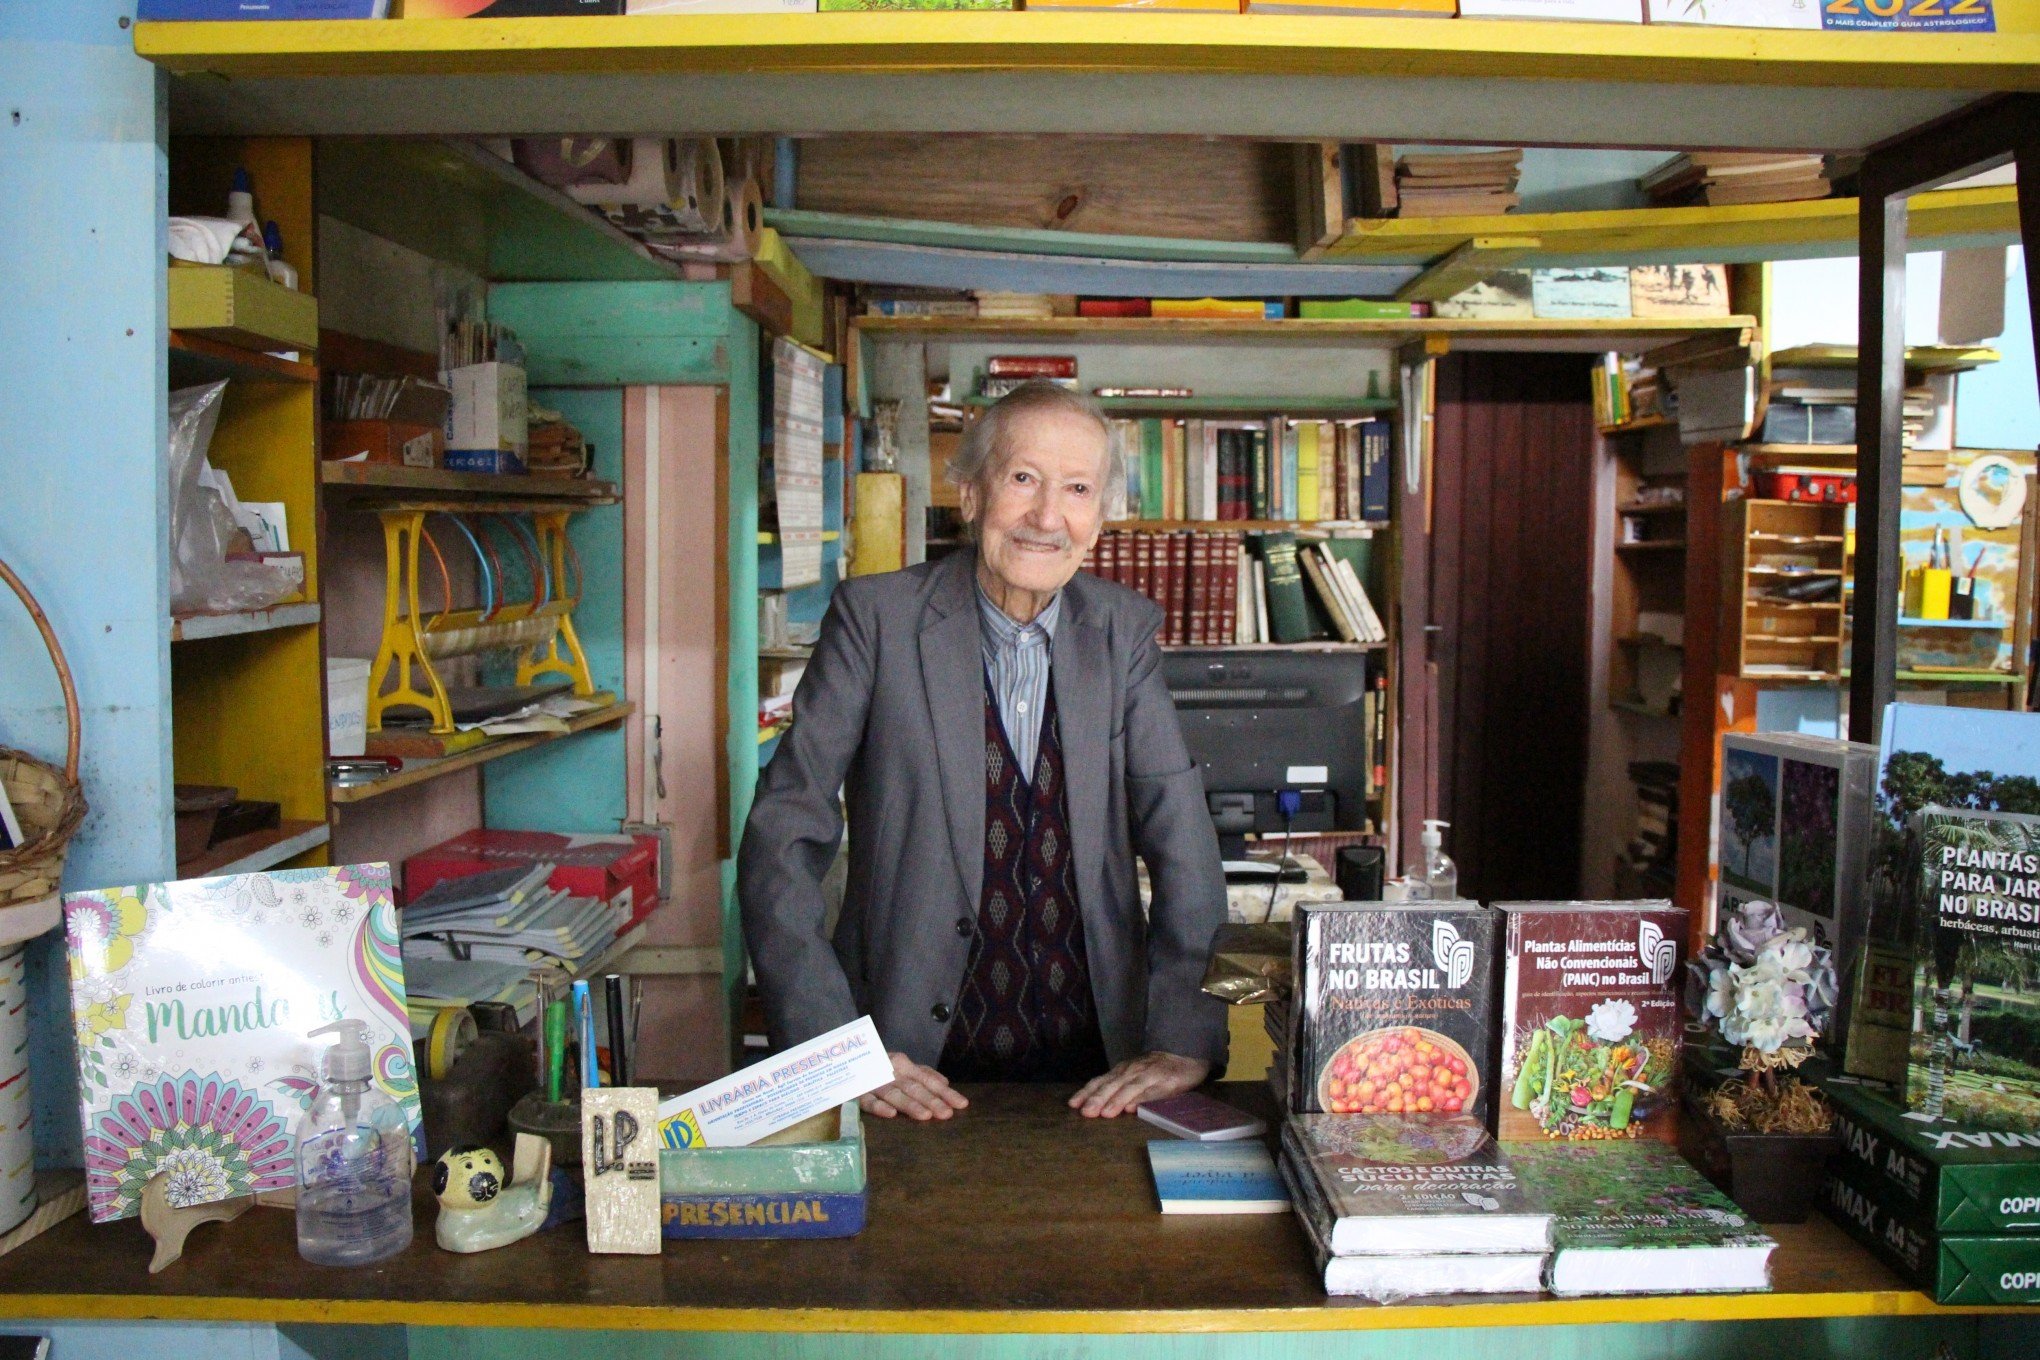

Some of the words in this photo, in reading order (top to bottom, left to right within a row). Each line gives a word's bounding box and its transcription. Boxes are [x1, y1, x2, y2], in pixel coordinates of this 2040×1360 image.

[1835, 18, 1855, 26] MAIS
[1856, 19, 1899, 28] COMPLETO
[1900, 20, 1922, 28] GUIA
[1942, 846, 2039, 874] PLANTAS
[1941, 870, 1996, 894] PARA
[2002, 877, 2040, 899] JAR
[1939, 894, 1968, 915] NO
[1975, 898, 2040, 924] BRASI
[1940, 916, 1999, 935] herbáceas,
[1329, 942, 1411, 963] FRUTAS
[1524, 939, 1566, 953] Plantas
[1567, 939, 1636, 953] Alimentícias
[1536, 955, 1558, 970] Não
[1559, 955, 1638, 969] Convencionais
[1329, 969, 1359, 989] NO
[1365, 968, 1440, 989] BRASIL
[1562, 972, 1600, 987] (PANC)
[1601, 976, 1616, 986] no
[1618, 971, 1650, 985] Brasil
[146, 985, 173, 996] Livro
[175, 982, 187, 992] de
[190, 979, 225, 991] colorir
[1331, 995, 1390, 1010] Nativas
[1394, 999, 1401, 1010] e
[1407, 992, 1472, 1009] Exóticas
[1651, 999, 1676, 1008] Edição
[699, 1075, 771, 1117] LIVRARIA
[772, 1034, 868, 1084] PRESENCIAL
[1337, 1166, 1417, 1175] CACTOS
[1417, 1165, 1429, 1174] E
[1433, 1165, 1510, 1174] OUTRAS
[1341, 1173, 1517, 1183] SUCULENTAS
[1353, 1182, 1407, 1194] para
[1412, 1180, 1517, 1192] decoração
[1414, 1191, 1457, 1201] EDIÇÃO
[661, 1200, 830, 1227] PRESENCIAL
[2000, 1197, 2040, 1214] COPI
[2000, 1272, 2040, 1289] COPI
